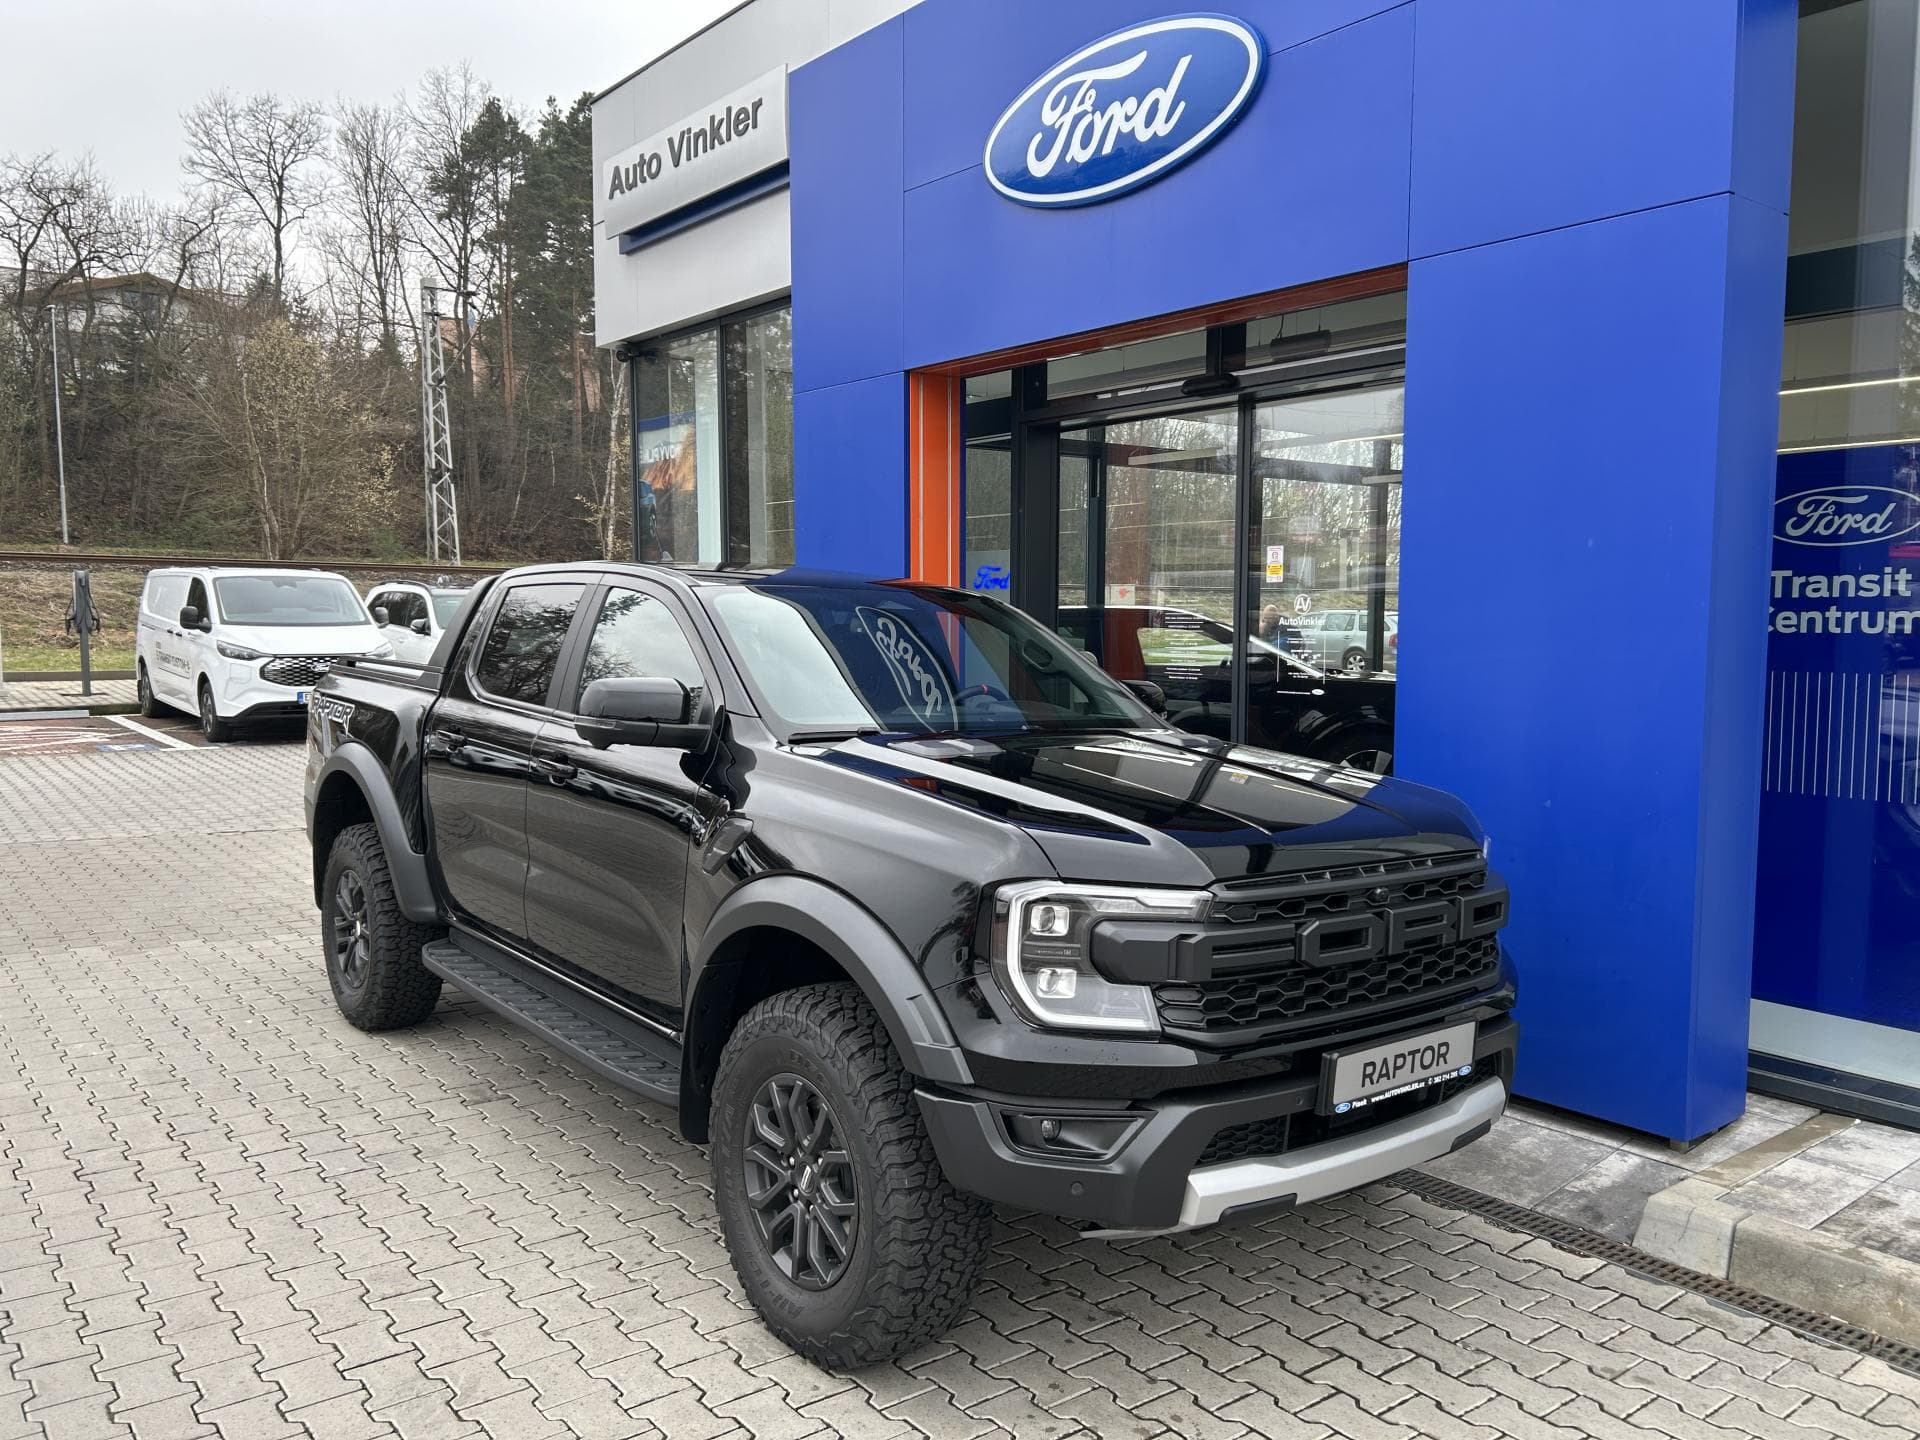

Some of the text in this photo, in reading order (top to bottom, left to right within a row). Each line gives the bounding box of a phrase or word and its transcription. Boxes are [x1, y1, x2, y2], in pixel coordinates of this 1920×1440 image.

[1026, 50, 1192, 178] Ford
[608, 97, 763, 200] Auto Vinkler
[1785, 494, 1897, 537] Ford
[973, 564, 1011, 590] Ford
[1771, 566, 1912, 599] Transit
[1278, 616, 1326, 626] AutoVinkler
[1295, 597, 1310, 612] AV
[1768, 605, 1920, 634] entrum
[312, 692, 355, 734] RAPTOR
[1169, 888, 1510, 984] FORD
[1361, 1041, 1450, 1088] RAPTOR
